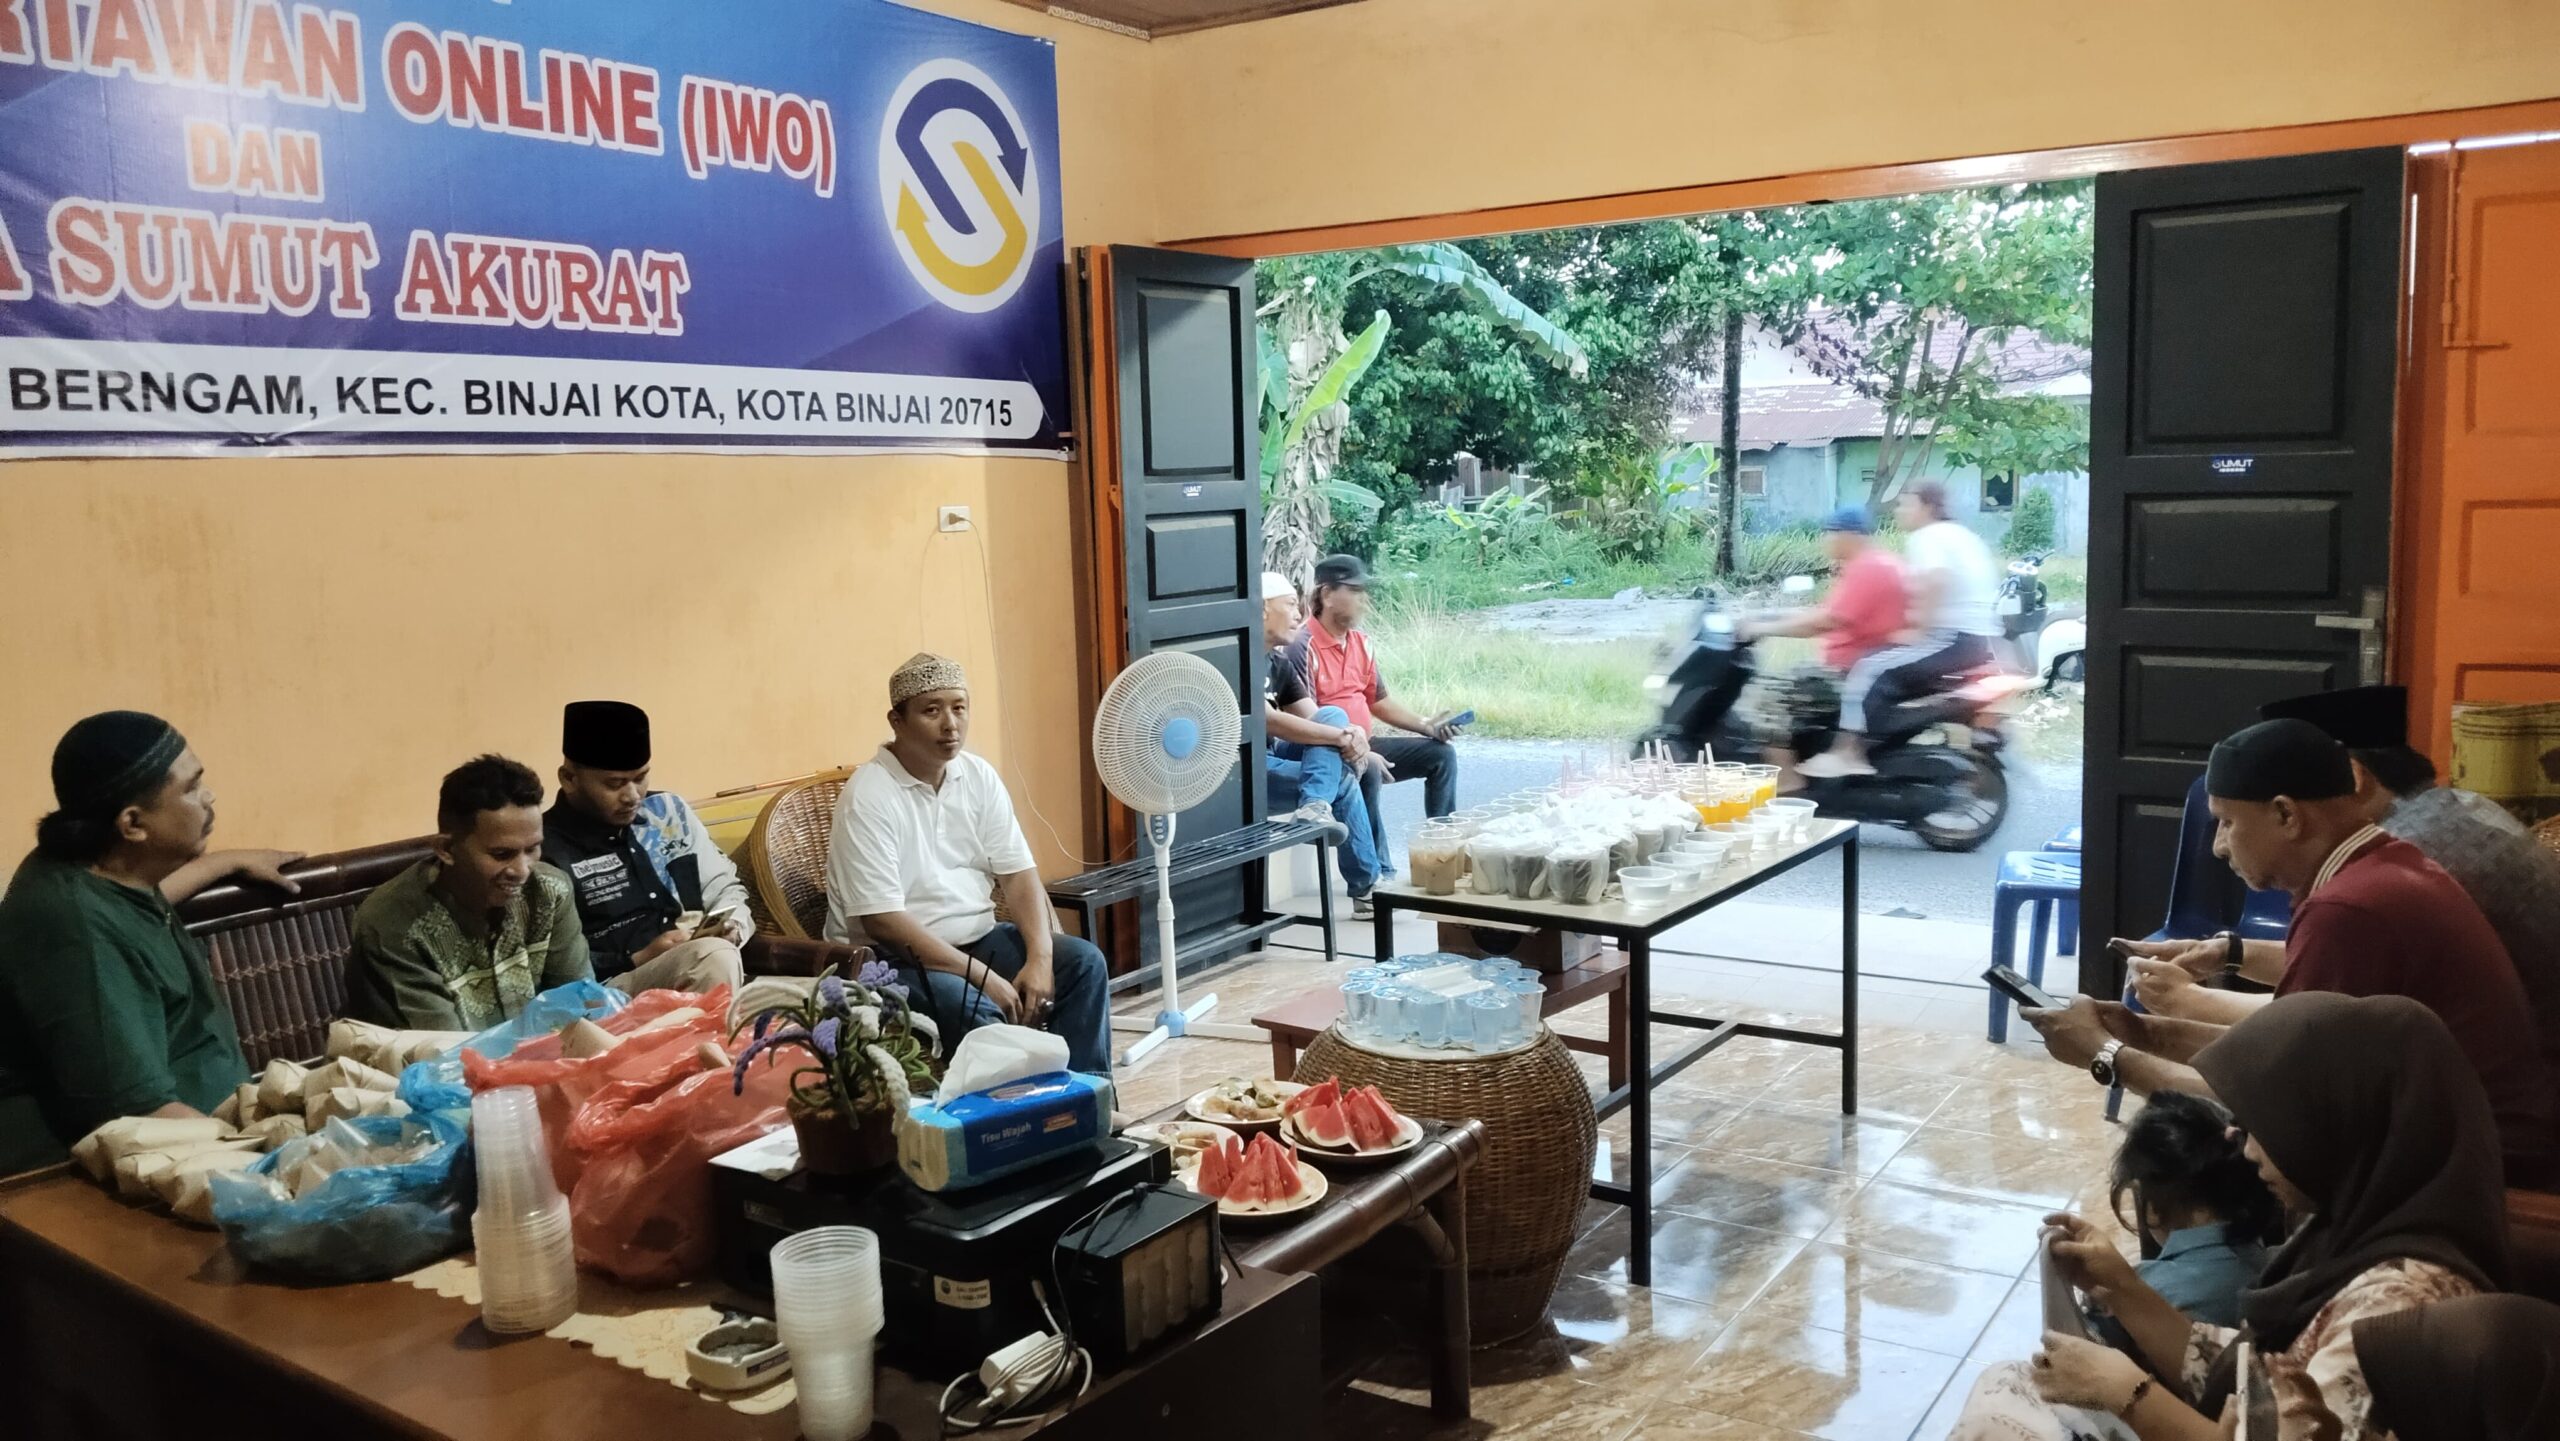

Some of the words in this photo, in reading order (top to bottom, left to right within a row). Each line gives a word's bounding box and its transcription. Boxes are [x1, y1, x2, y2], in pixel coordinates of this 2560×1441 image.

[185, 119, 324, 201] DAN
[383, 23, 663, 154] ONLINE
[680, 76, 835, 196] (IWO)
[48, 198, 379, 317] SUMUT
[396, 231, 690, 336] AKURAT
[9, 367, 318, 420] BERNGAM,
[336, 376, 447, 416] KEC.
[464, 380, 600, 417] BINJAI
[614, 384, 725, 426] KOTA,
[737, 388, 827, 423] KOTA
[836, 391, 930, 426] BINJAI
[940, 396, 1012, 427] 20715
